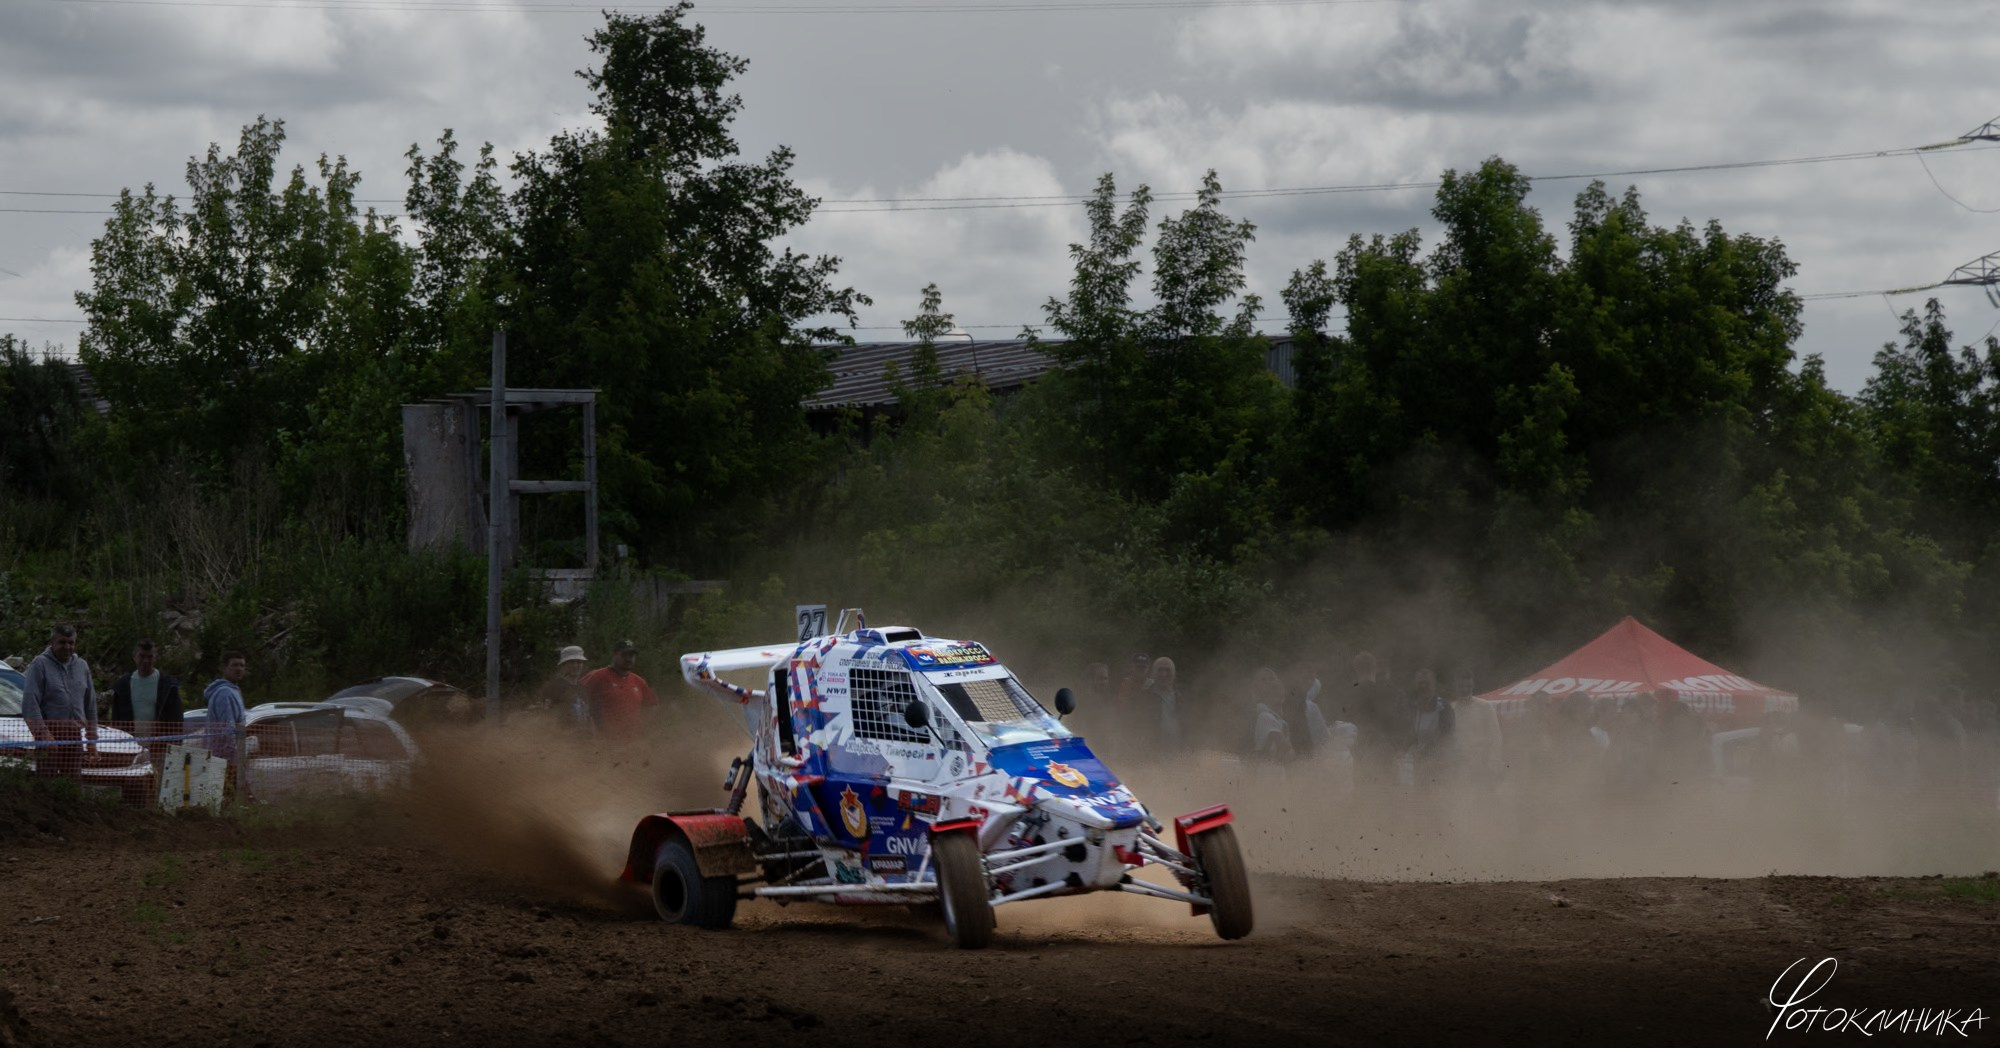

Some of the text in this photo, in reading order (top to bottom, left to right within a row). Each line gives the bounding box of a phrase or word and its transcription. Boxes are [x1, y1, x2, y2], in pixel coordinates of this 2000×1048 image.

[799, 608, 826, 641] 27
[1500, 677, 1643, 697] MOTUL
[1657, 675, 1764, 691] MOTUL
[886, 744, 925, 759] Тимофей
[886, 836, 918, 854] GNV
